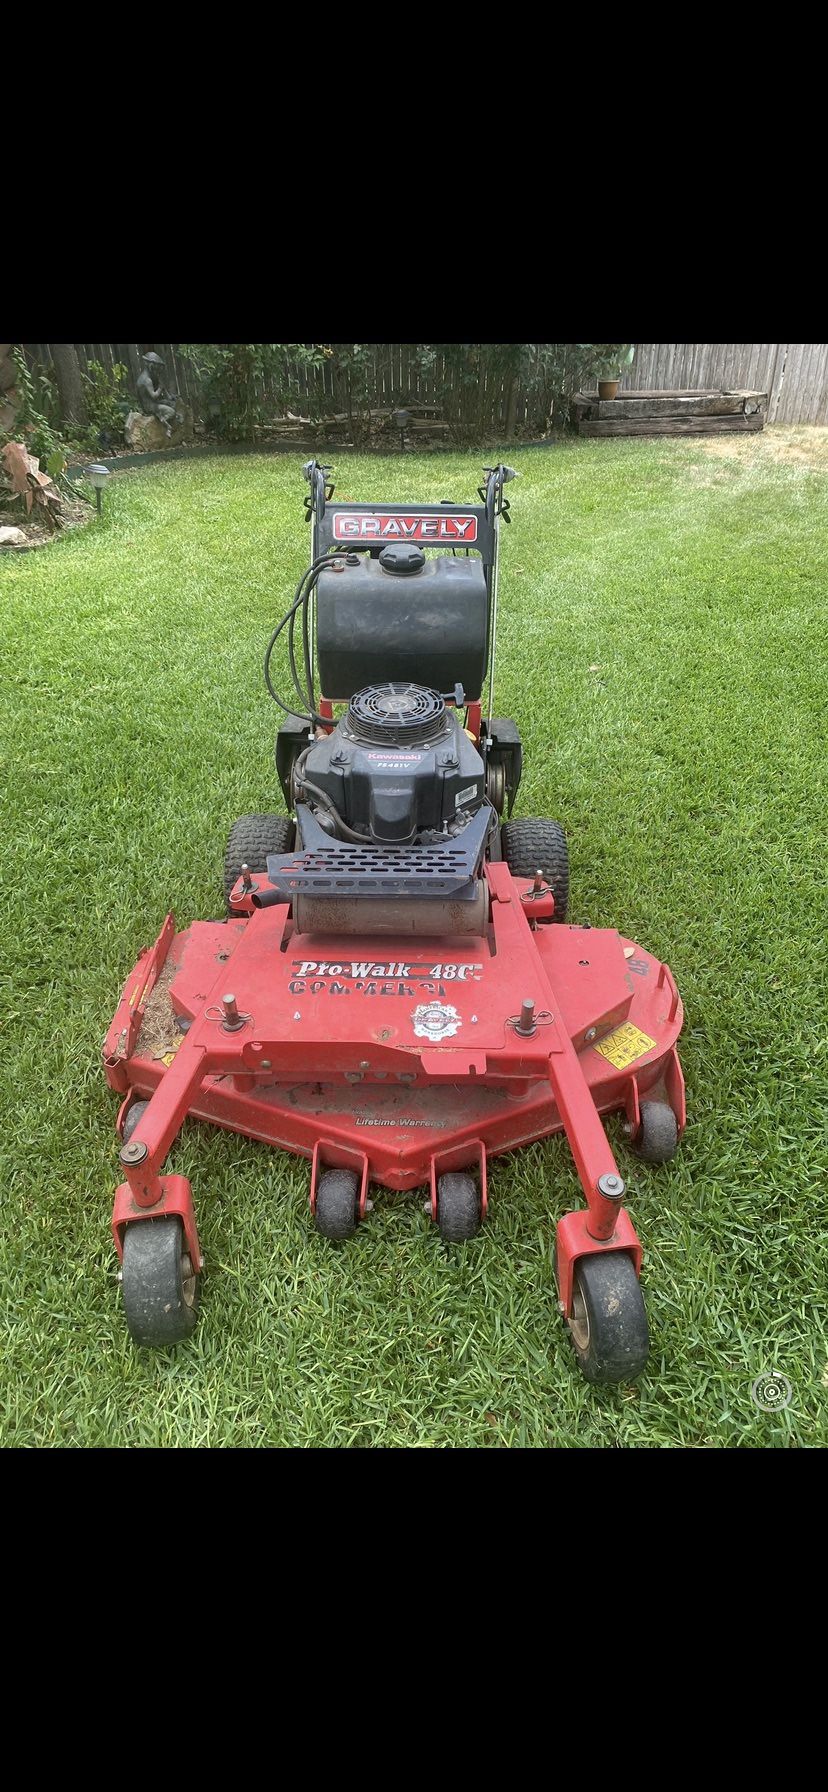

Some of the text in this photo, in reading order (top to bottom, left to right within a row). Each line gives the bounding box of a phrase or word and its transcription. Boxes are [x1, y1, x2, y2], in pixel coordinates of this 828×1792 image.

[340, 517, 474, 537] GRAVELY
[295, 962, 412, 979] Pro-Walk
[355, 1117, 397, 1126] Lifetime
